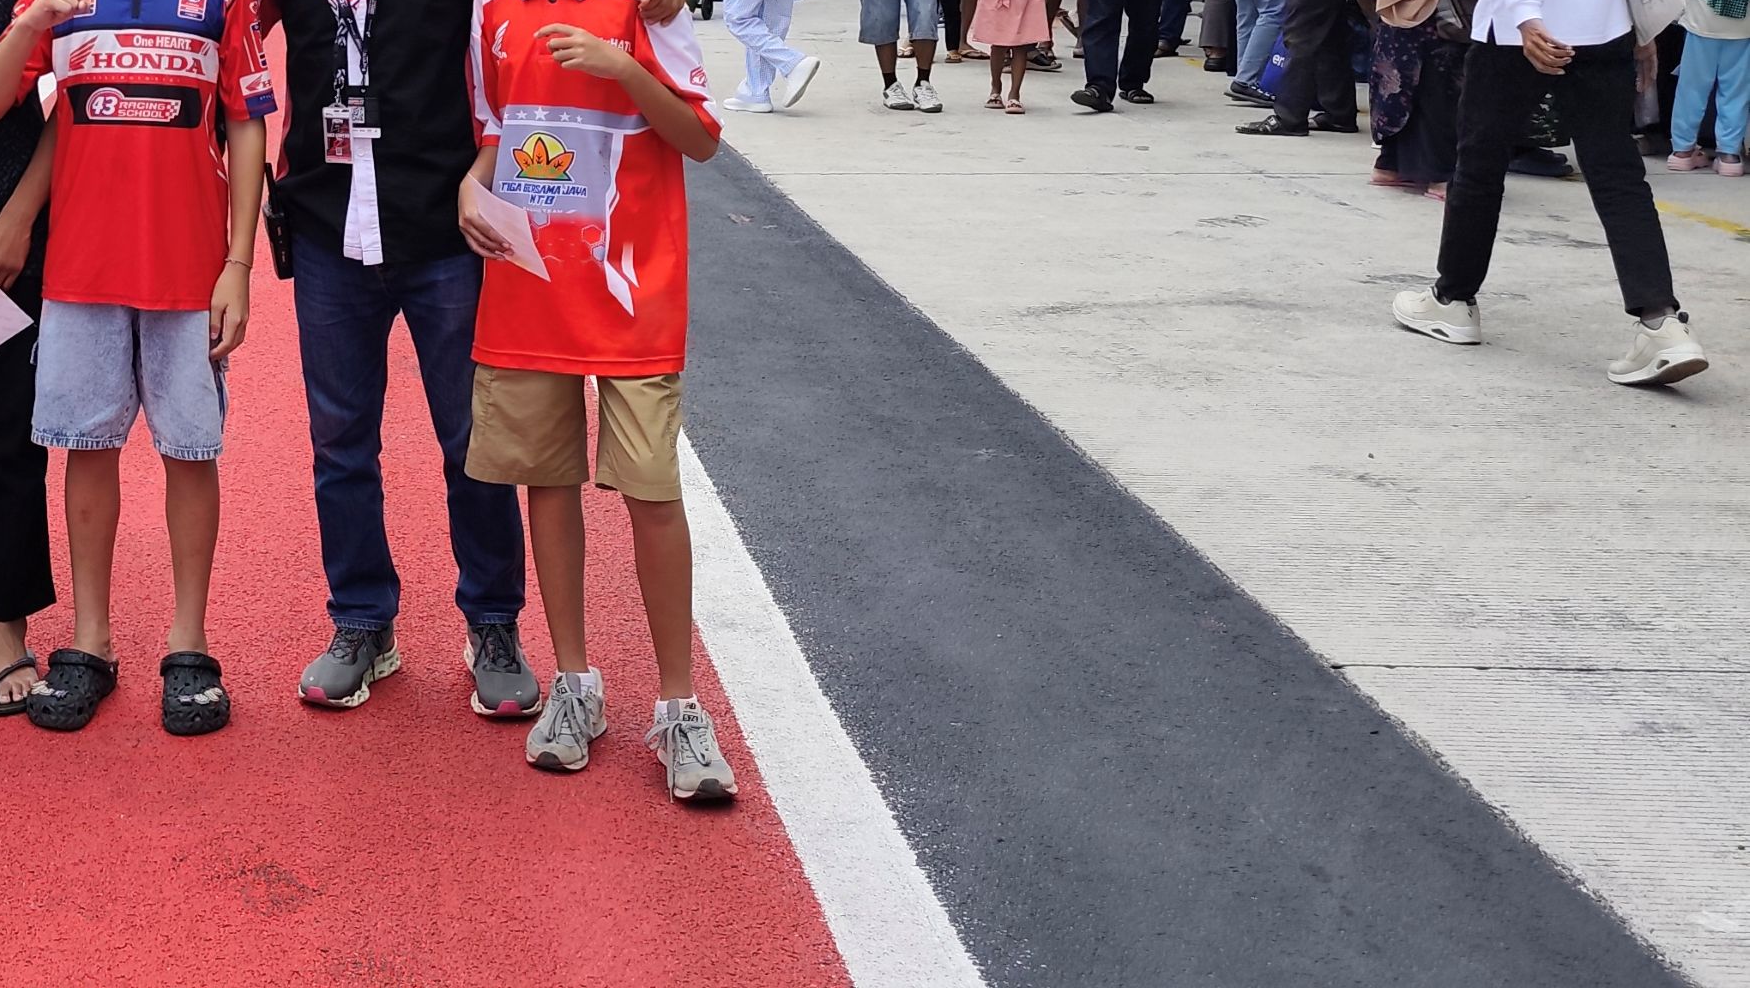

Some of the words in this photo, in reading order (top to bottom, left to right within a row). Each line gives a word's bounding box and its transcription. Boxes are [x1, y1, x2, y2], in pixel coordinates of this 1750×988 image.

[133, 35, 154, 48] One
[92, 52, 206, 77] HONDA
[92, 96, 118, 116] 43
[118, 101, 166, 111] RACING
[117, 110, 165, 119] SCHOOL
[500, 181, 522, 192] TIGA
[523, 183, 562, 195] BERSAMA
[561, 185, 587, 197] JAYA
[529, 194, 556, 205] NTB
